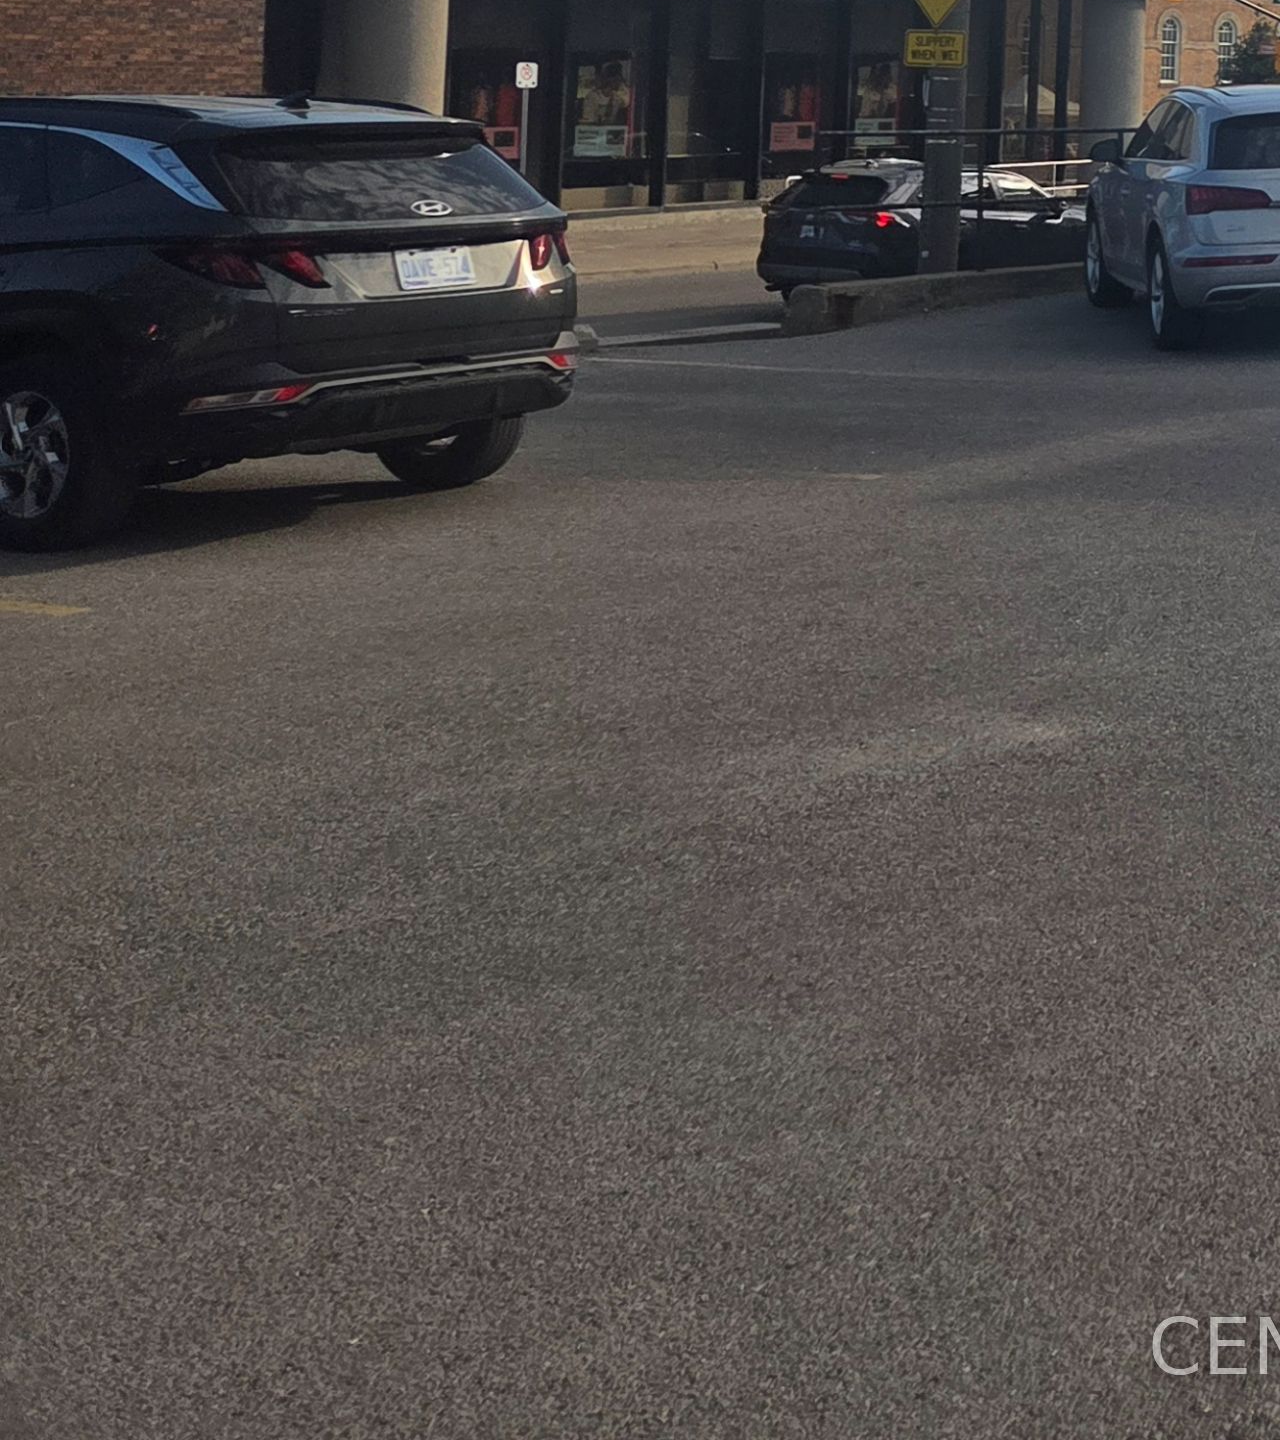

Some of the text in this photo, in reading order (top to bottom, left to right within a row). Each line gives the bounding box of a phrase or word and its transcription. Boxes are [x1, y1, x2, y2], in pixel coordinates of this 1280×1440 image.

[914, 35, 956, 48] SLIPPERY
[911, 49, 960, 61] WHEN WET
